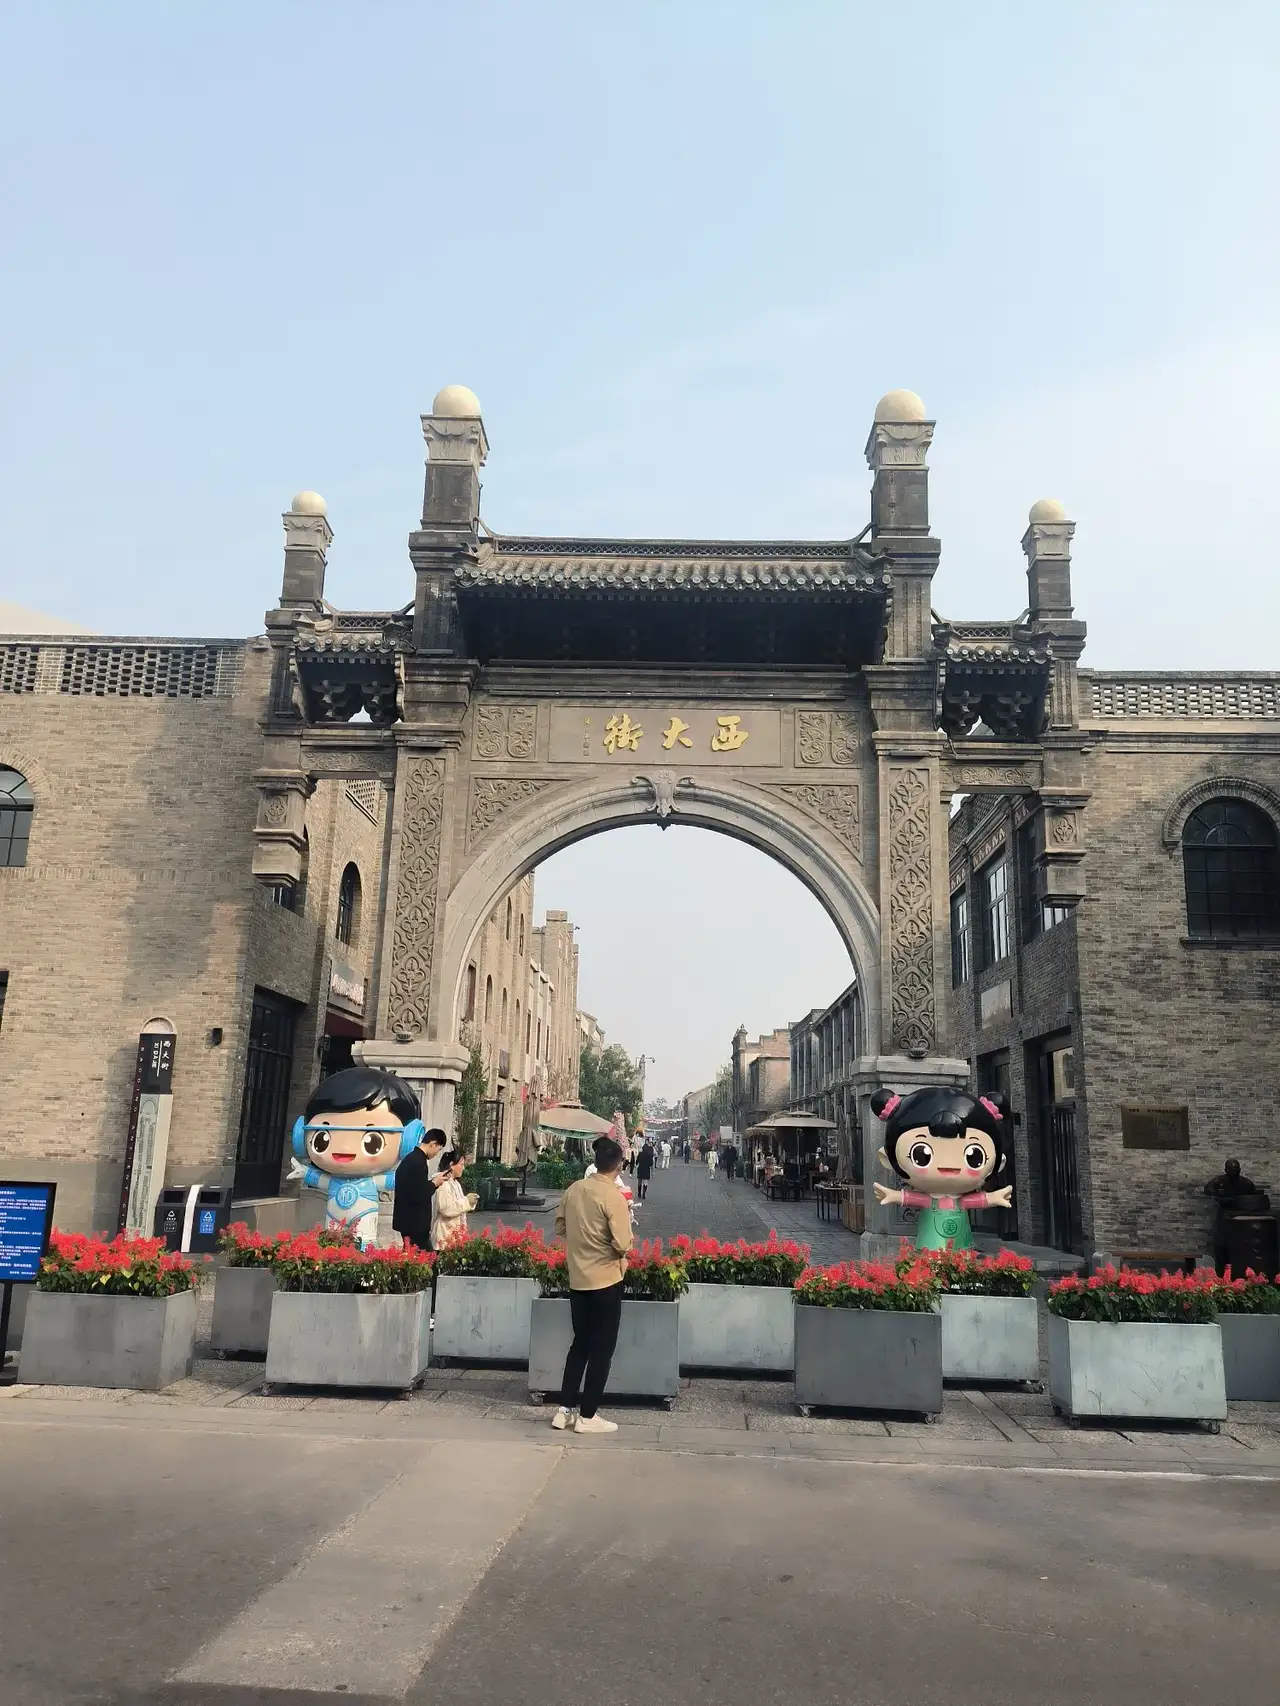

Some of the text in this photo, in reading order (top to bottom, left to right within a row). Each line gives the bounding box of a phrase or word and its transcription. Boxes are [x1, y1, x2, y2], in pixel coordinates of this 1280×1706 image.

[603, 713, 749, 755] 西大街
[161, 1040, 171, 1070] 西大街
